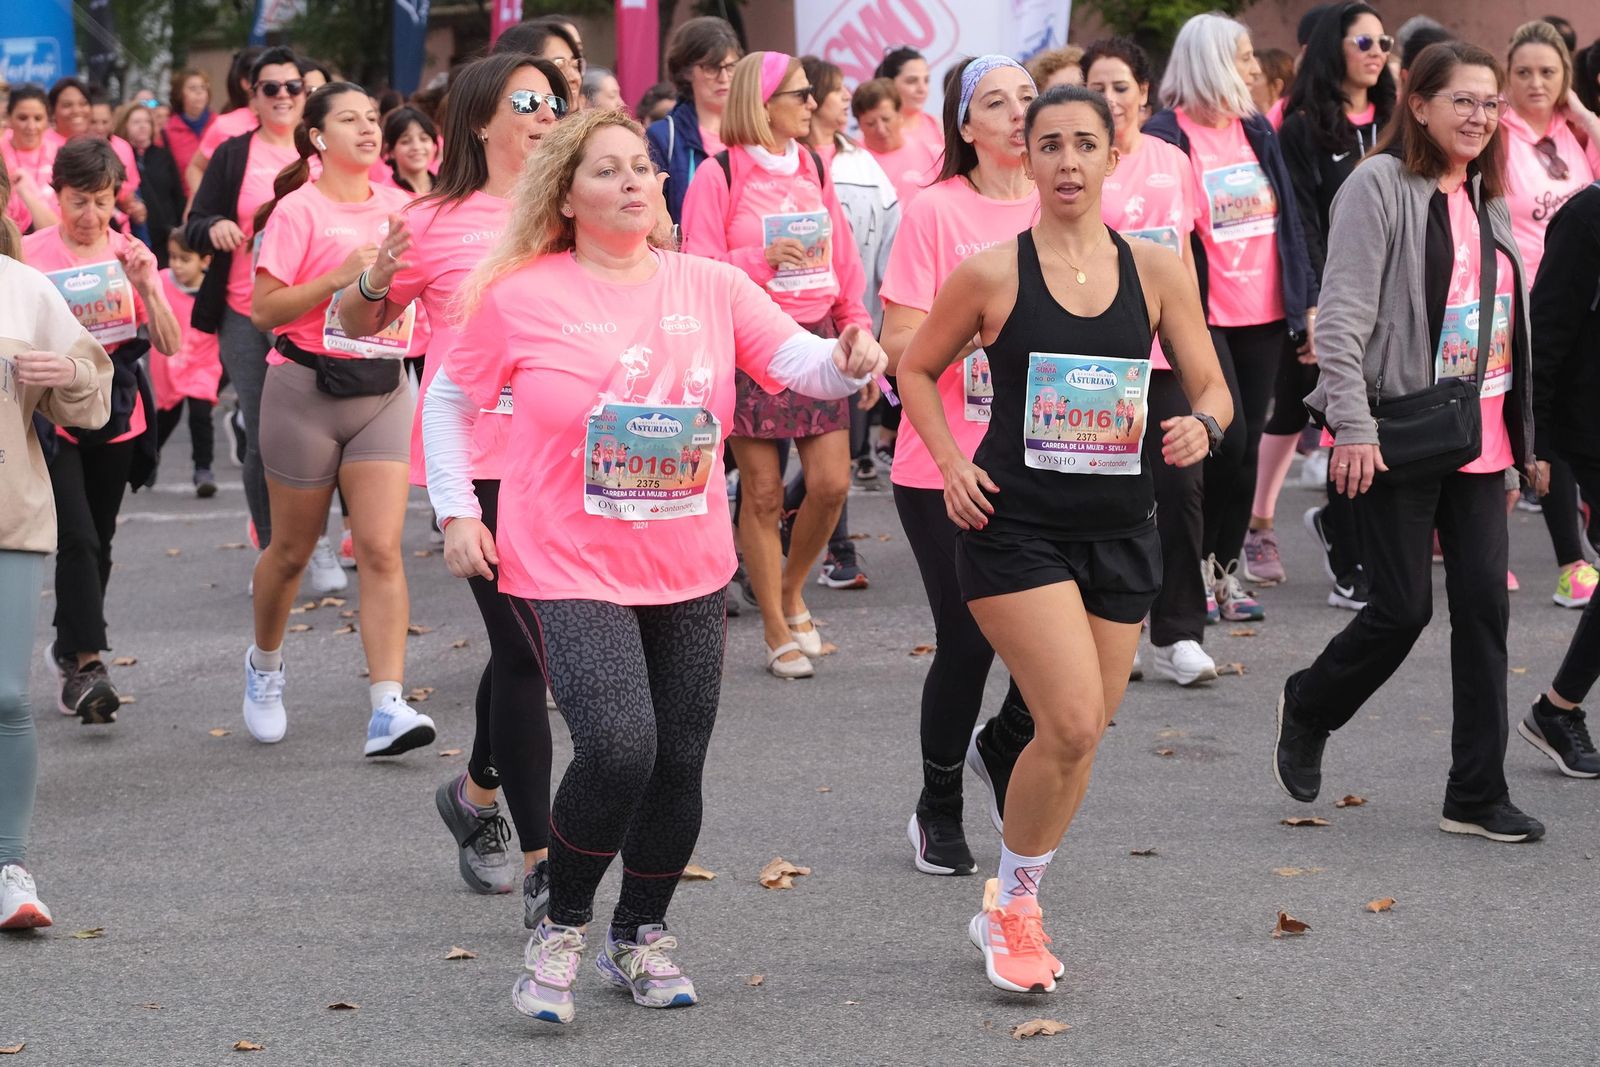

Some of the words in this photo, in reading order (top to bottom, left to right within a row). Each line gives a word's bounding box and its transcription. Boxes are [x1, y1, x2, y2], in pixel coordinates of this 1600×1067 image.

[72, 299, 105, 318] 016
[562, 322, 617, 335] OYSHO
[1069, 374, 1115, 386] ASTURIANA
[1068, 408, 1112, 429] 016
[629, 420, 679, 433] ASTURIANA
[1076, 432, 1098, 442] 2373
[1041, 441, 1068, 450] CARRERA
[628, 455, 677, 476] 016
[1037, 454, 1076, 467] OYSHO
[1098, 460, 1128, 468] Santander
[636, 479, 660, 489] 2375
[602, 488, 628, 498] CARRERA
[672, 489, 693, 497] SEVILLA
[598, 500, 635, 513] OYSHO
[632, 521, 649, 530] 2024
